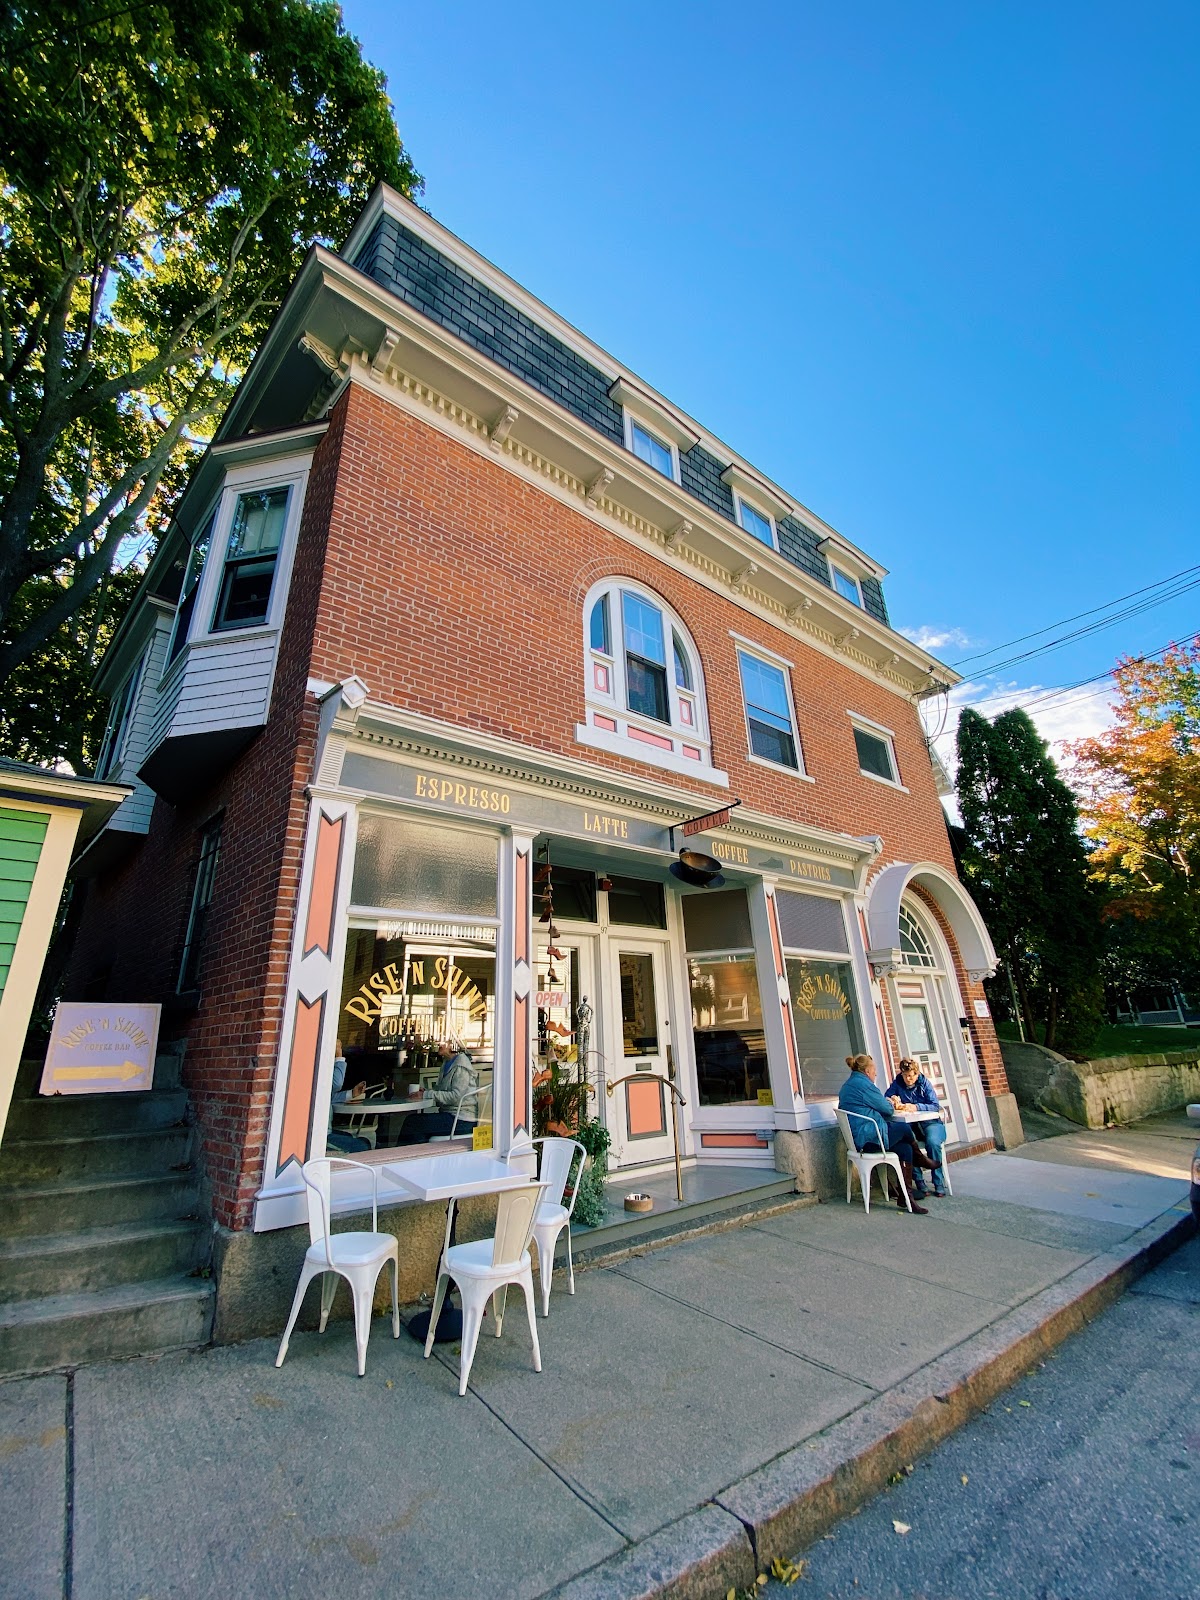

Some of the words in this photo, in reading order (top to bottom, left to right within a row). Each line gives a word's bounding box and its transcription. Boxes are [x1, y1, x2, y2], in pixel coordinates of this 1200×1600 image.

[415, 774, 510, 814] ESPRESSO
[584, 812, 628, 838] LATTE
[687, 812, 725, 834] COFFEE
[711, 841, 749, 864] COFFEE
[789, 859, 831, 881] PASTRIES
[600, 926, 608, 934] 97
[344, 962, 404, 1027] RISE
[430, 957, 488, 1023] SHINE
[535, 991, 563, 1007] OPEN
[797, 977, 816, 1014] RISE
[825, 974, 851, 1015] SHINE
[59, 1019, 96, 1049] RISE
[113, 1016, 149, 1049] SHINE
[114, 1043, 131, 1051] BAR
